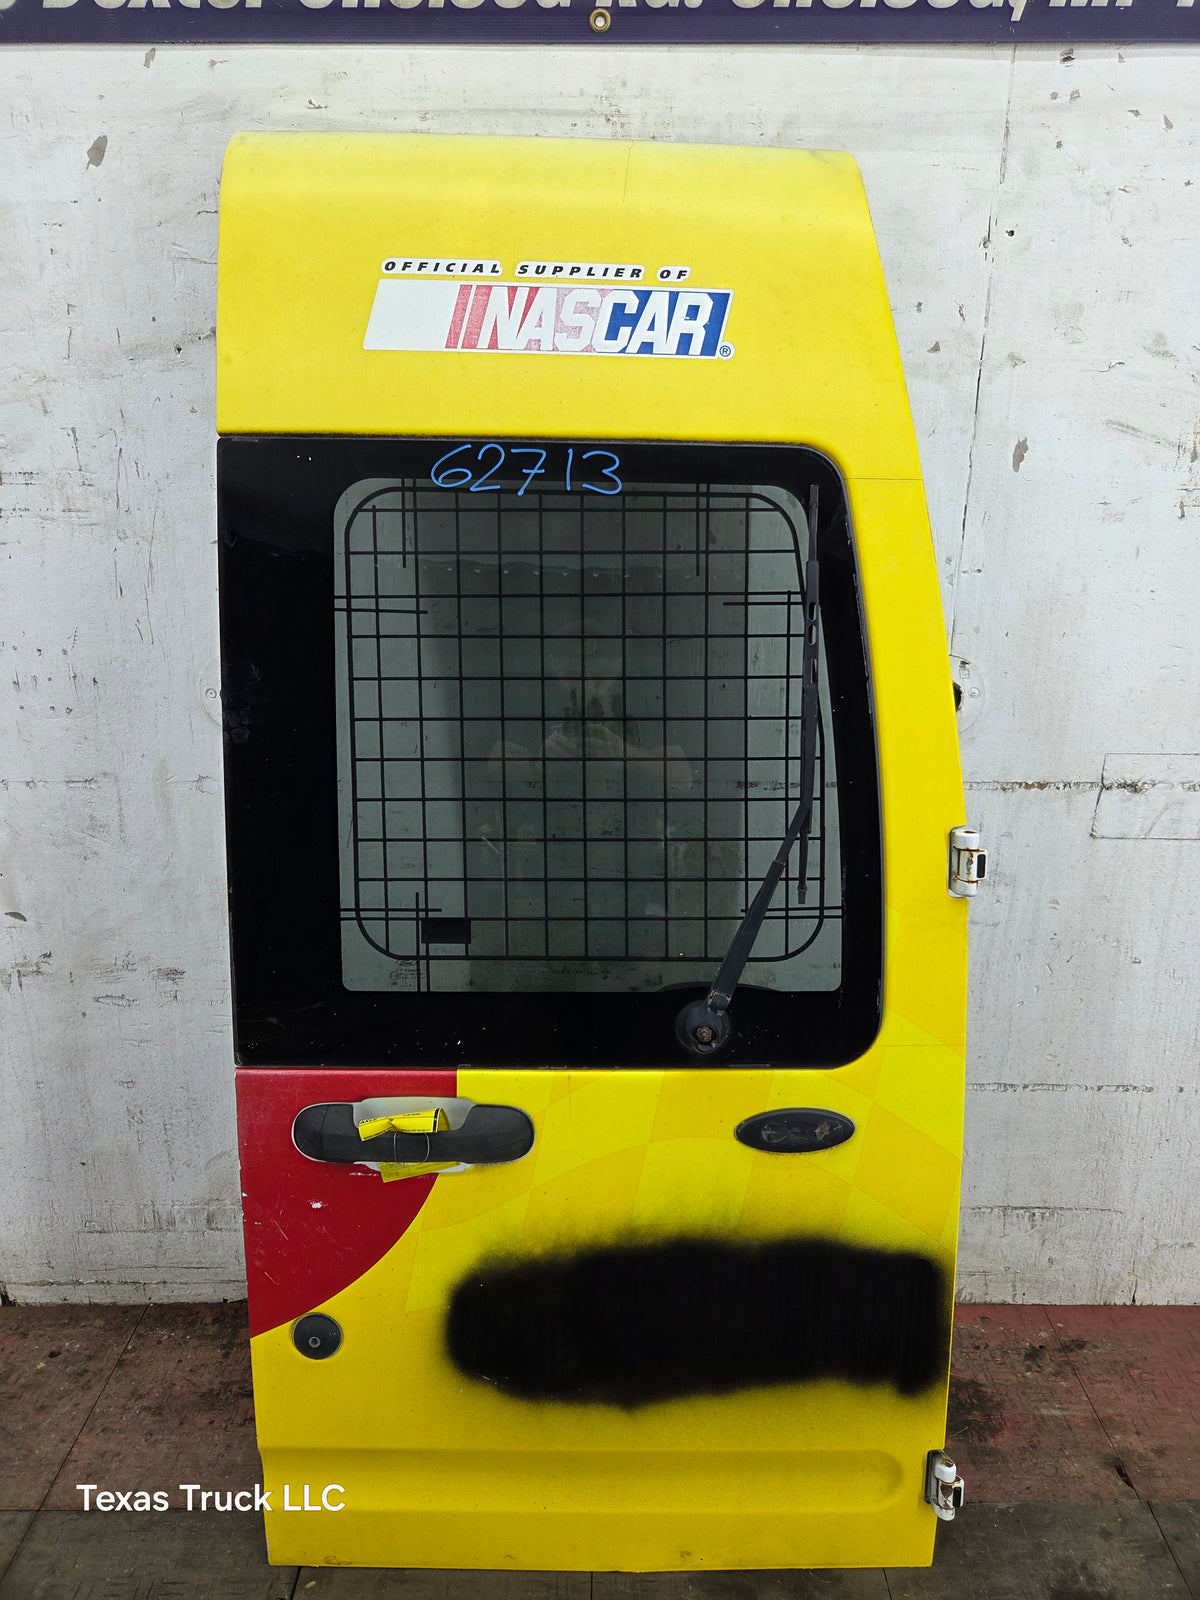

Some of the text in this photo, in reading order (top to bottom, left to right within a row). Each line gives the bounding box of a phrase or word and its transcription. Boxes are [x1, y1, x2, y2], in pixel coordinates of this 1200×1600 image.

[384, 261, 689, 280] OFFICIAL SUPPLIER OF
[477, 286, 714, 355] NASCAR
[430, 443, 623, 496] 62713
